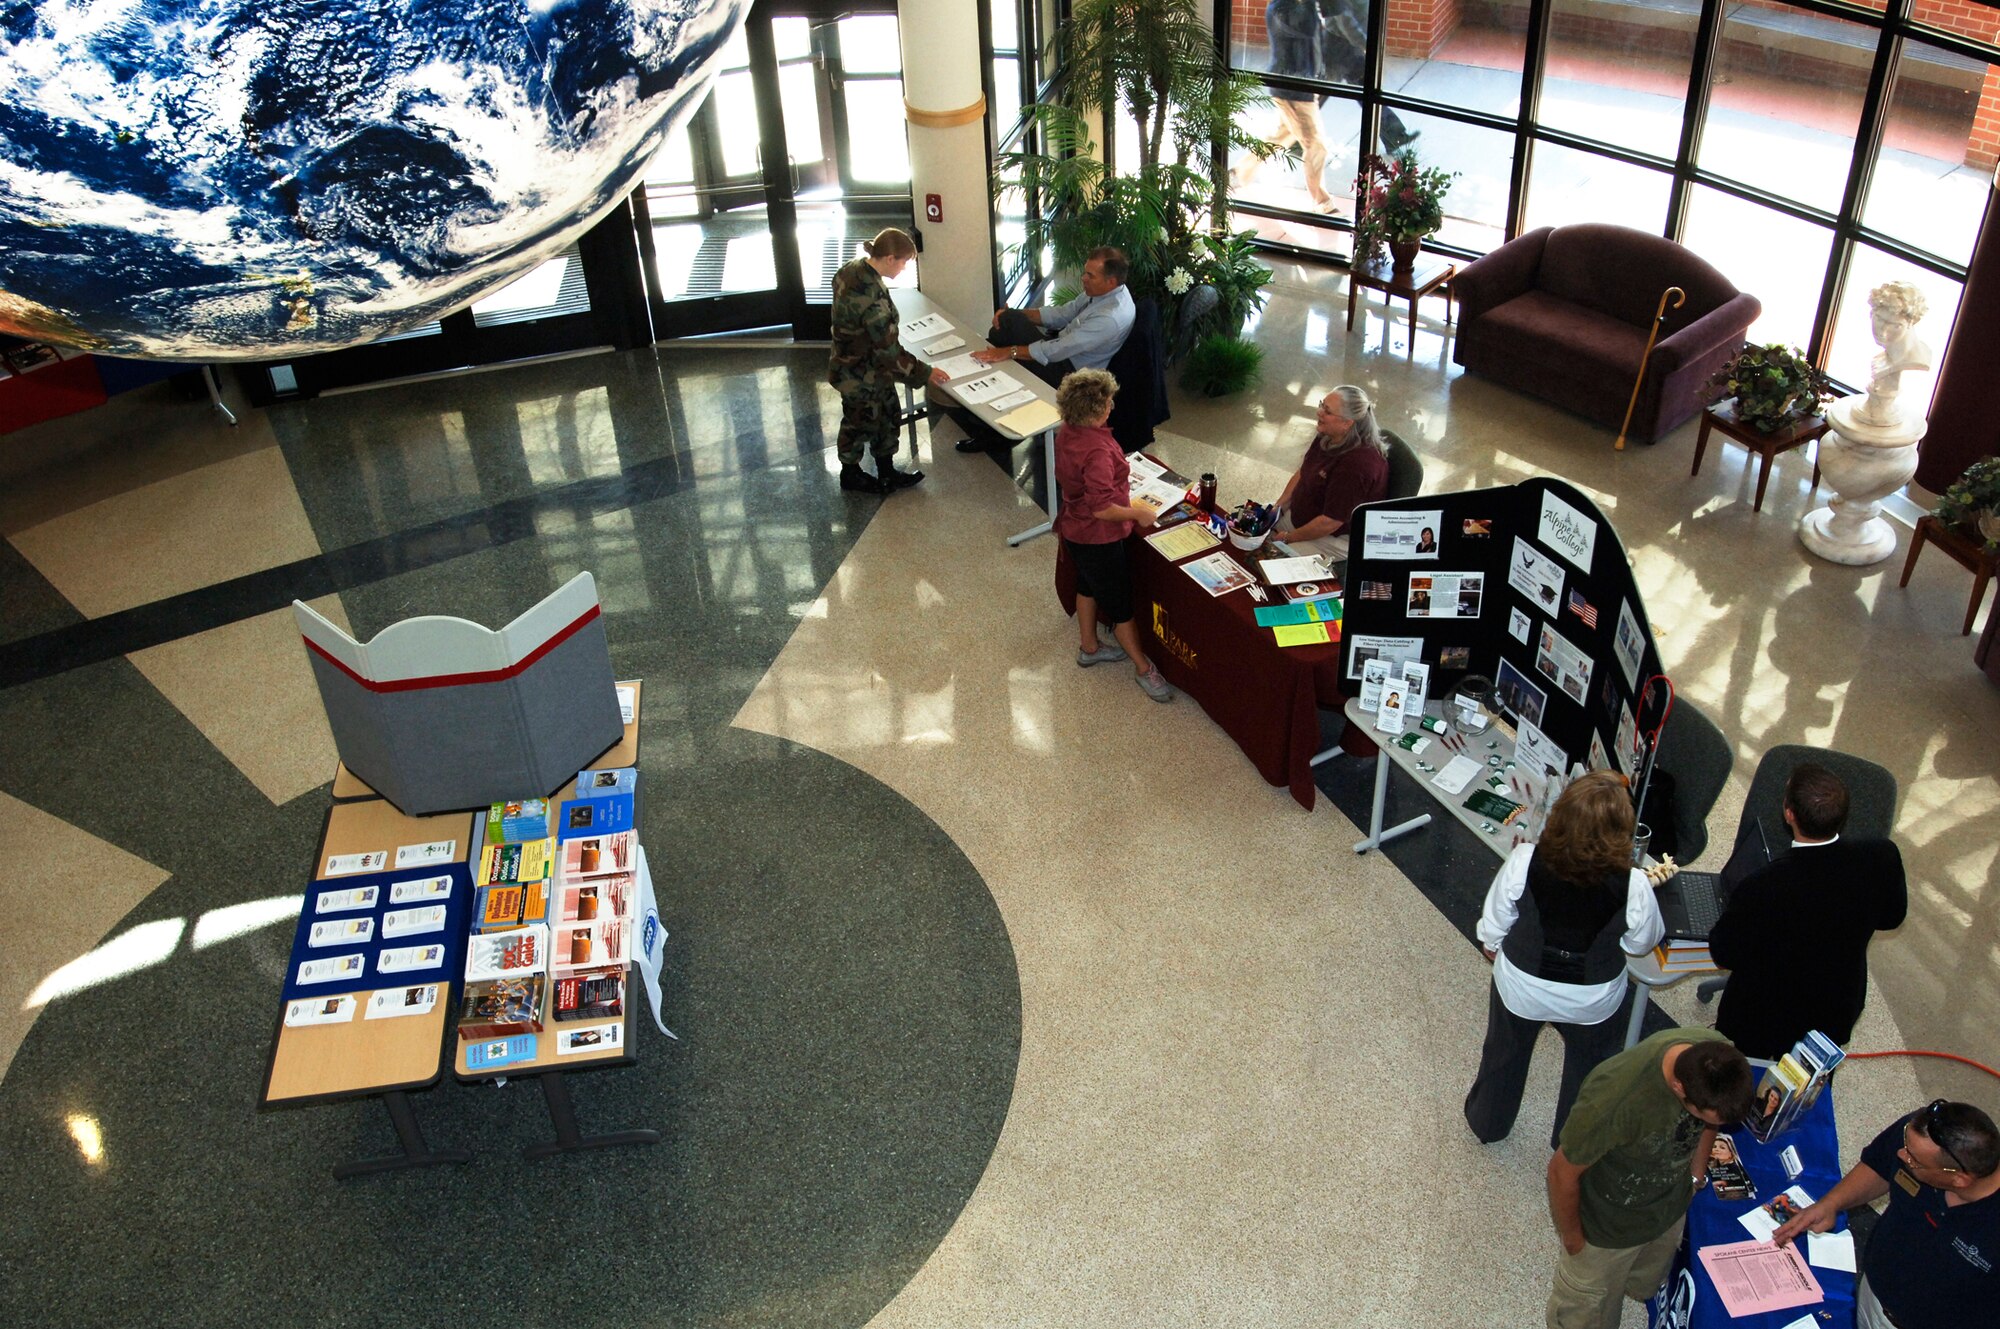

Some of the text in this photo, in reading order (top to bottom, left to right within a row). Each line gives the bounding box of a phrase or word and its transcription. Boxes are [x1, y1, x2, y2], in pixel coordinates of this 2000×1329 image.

[1543, 509, 1571, 535] Alpine
[1555, 528, 1584, 557] College
[490, 848, 502, 882] Occupational
[500, 860, 509, 881] Outlook
[510, 853, 520, 880] Handbook
[491, 891, 504, 919] Distance
[501, 890, 515, 918] Learning
[502, 945, 517, 970] SOC
[522, 935, 535, 967] Guide
[1757, 1245, 1772, 1253] NEWS
